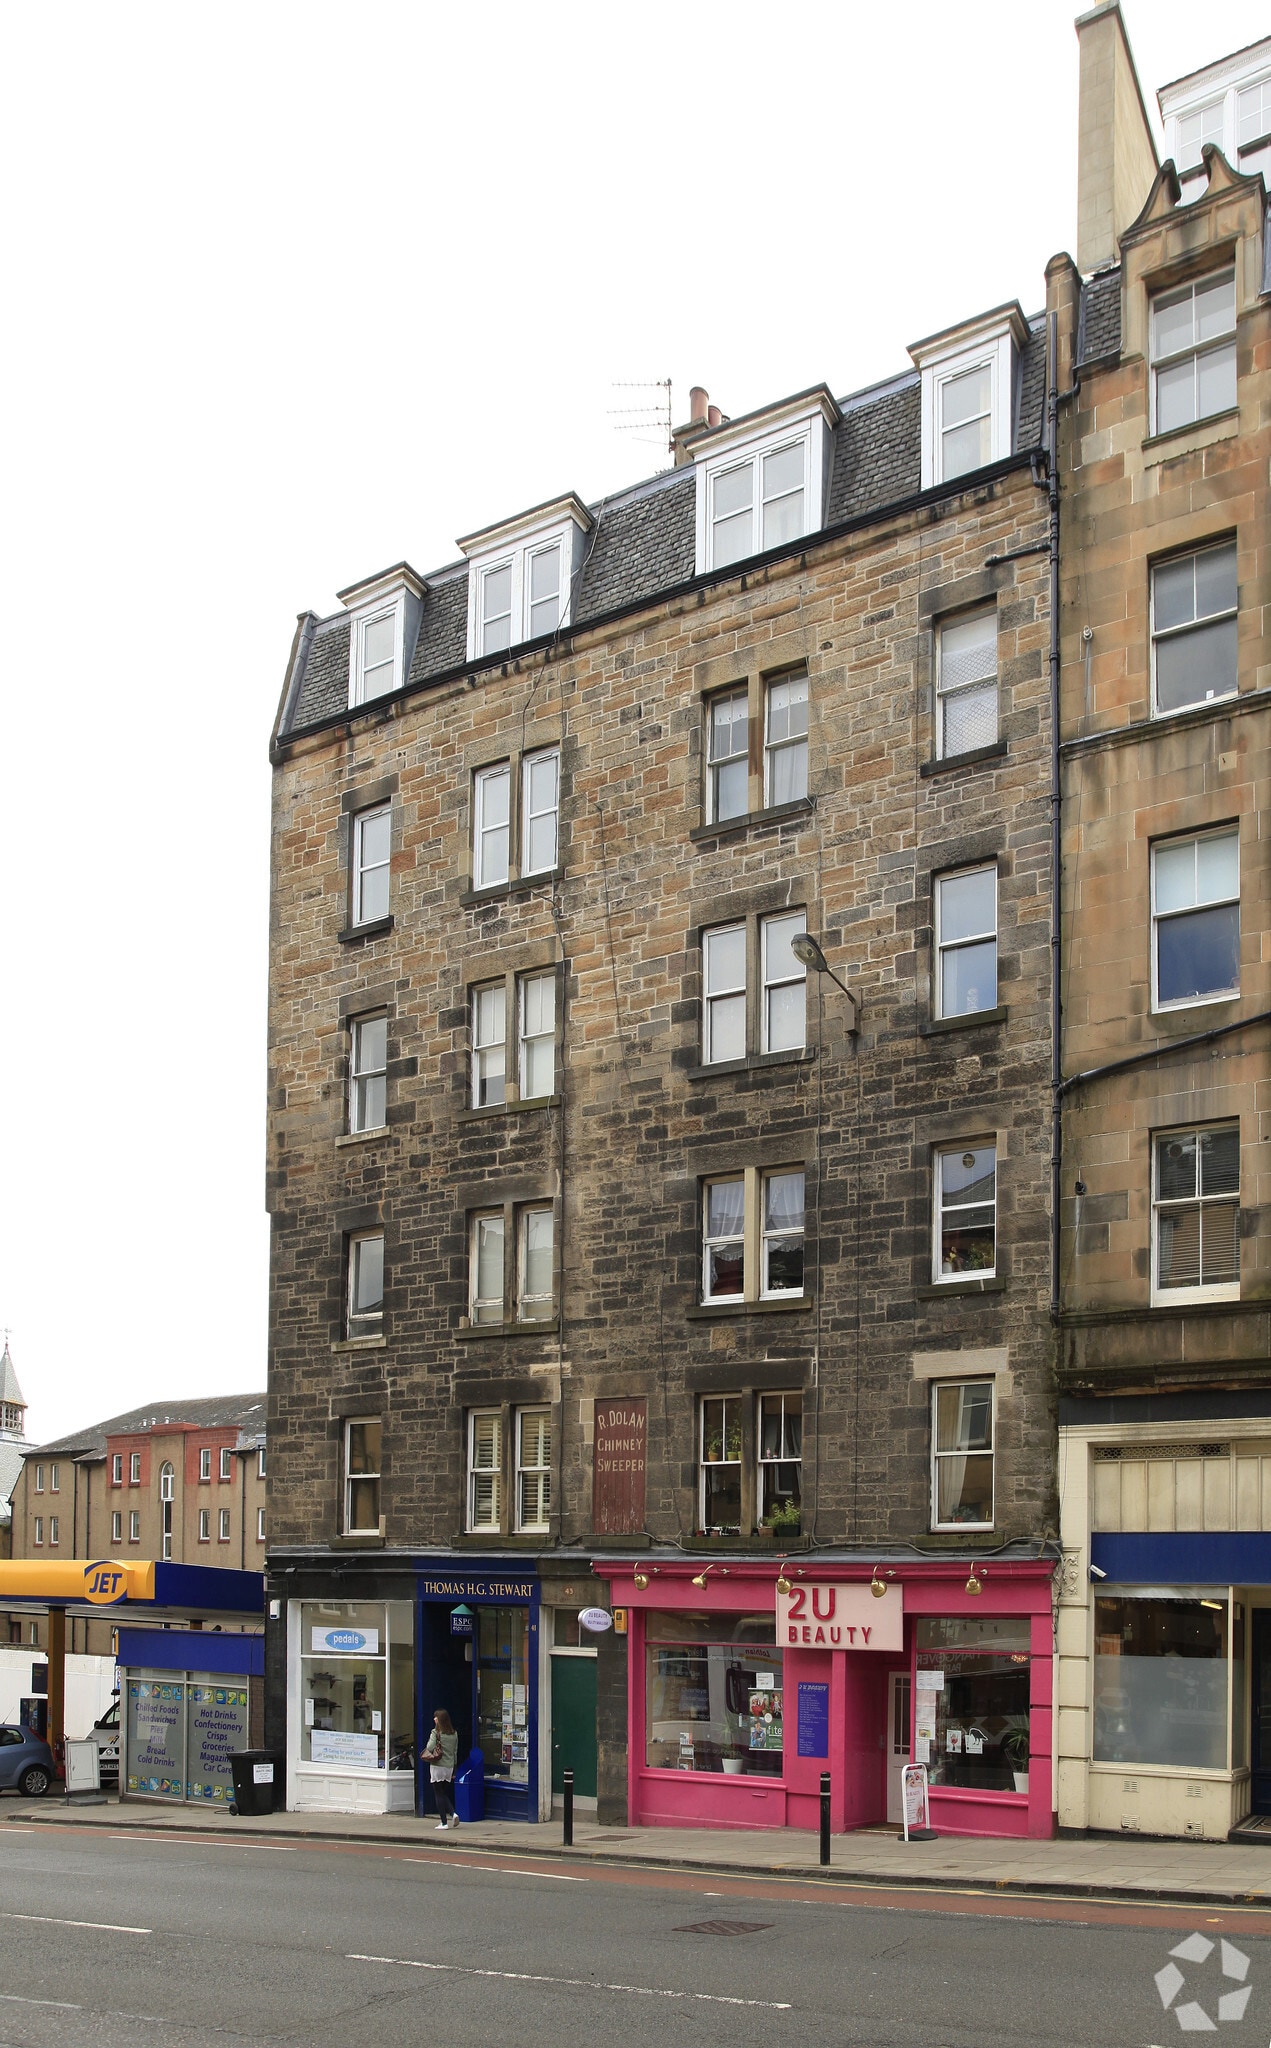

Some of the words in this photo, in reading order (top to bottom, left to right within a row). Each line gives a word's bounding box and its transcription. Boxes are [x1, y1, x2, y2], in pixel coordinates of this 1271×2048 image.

[597, 1438, 643, 1452] CHIMNEY
[597, 1459, 644, 1472] SWEEPER
[89, 1572, 123, 1594] JET
[424, 1581, 465, 1595] THOMAS
[467, 1583, 487, 1595] H.G.
[489, 1584, 534, 1597] STEWART
[787, 1587, 837, 1622] 2U
[453, 1617, 473, 1626] ESPC
[333, 1634, 360, 1645] pedals
[788, 1625, 872, 1644] BEAUTY
[135, 1703, 158, 1713] Chilled
[160, 1705, 179, 1715] Foods
[200, 1709, 212, 1718] Hot
[214, 1710, 237, 1720] Drinks
[138, 1713, 177, 1725] Sandwiches
[150, 1725, 164, 1734] Pies
[194, 1719, 243, 1734] Confectionery
[206, 1731, 228, 1742] Crisps
[147, 1745, 166, 1755] Bread
[202, 1741, 235, 1752] Groceries
[138, 1755, 152, 1764] Cold
[154, 1757, 175, 1767] Drinks
[200, 1752, 230, 1763] Magazin
[203, 1763, 215, 1772] Car
[217, 1765, 232, 1775] Care
